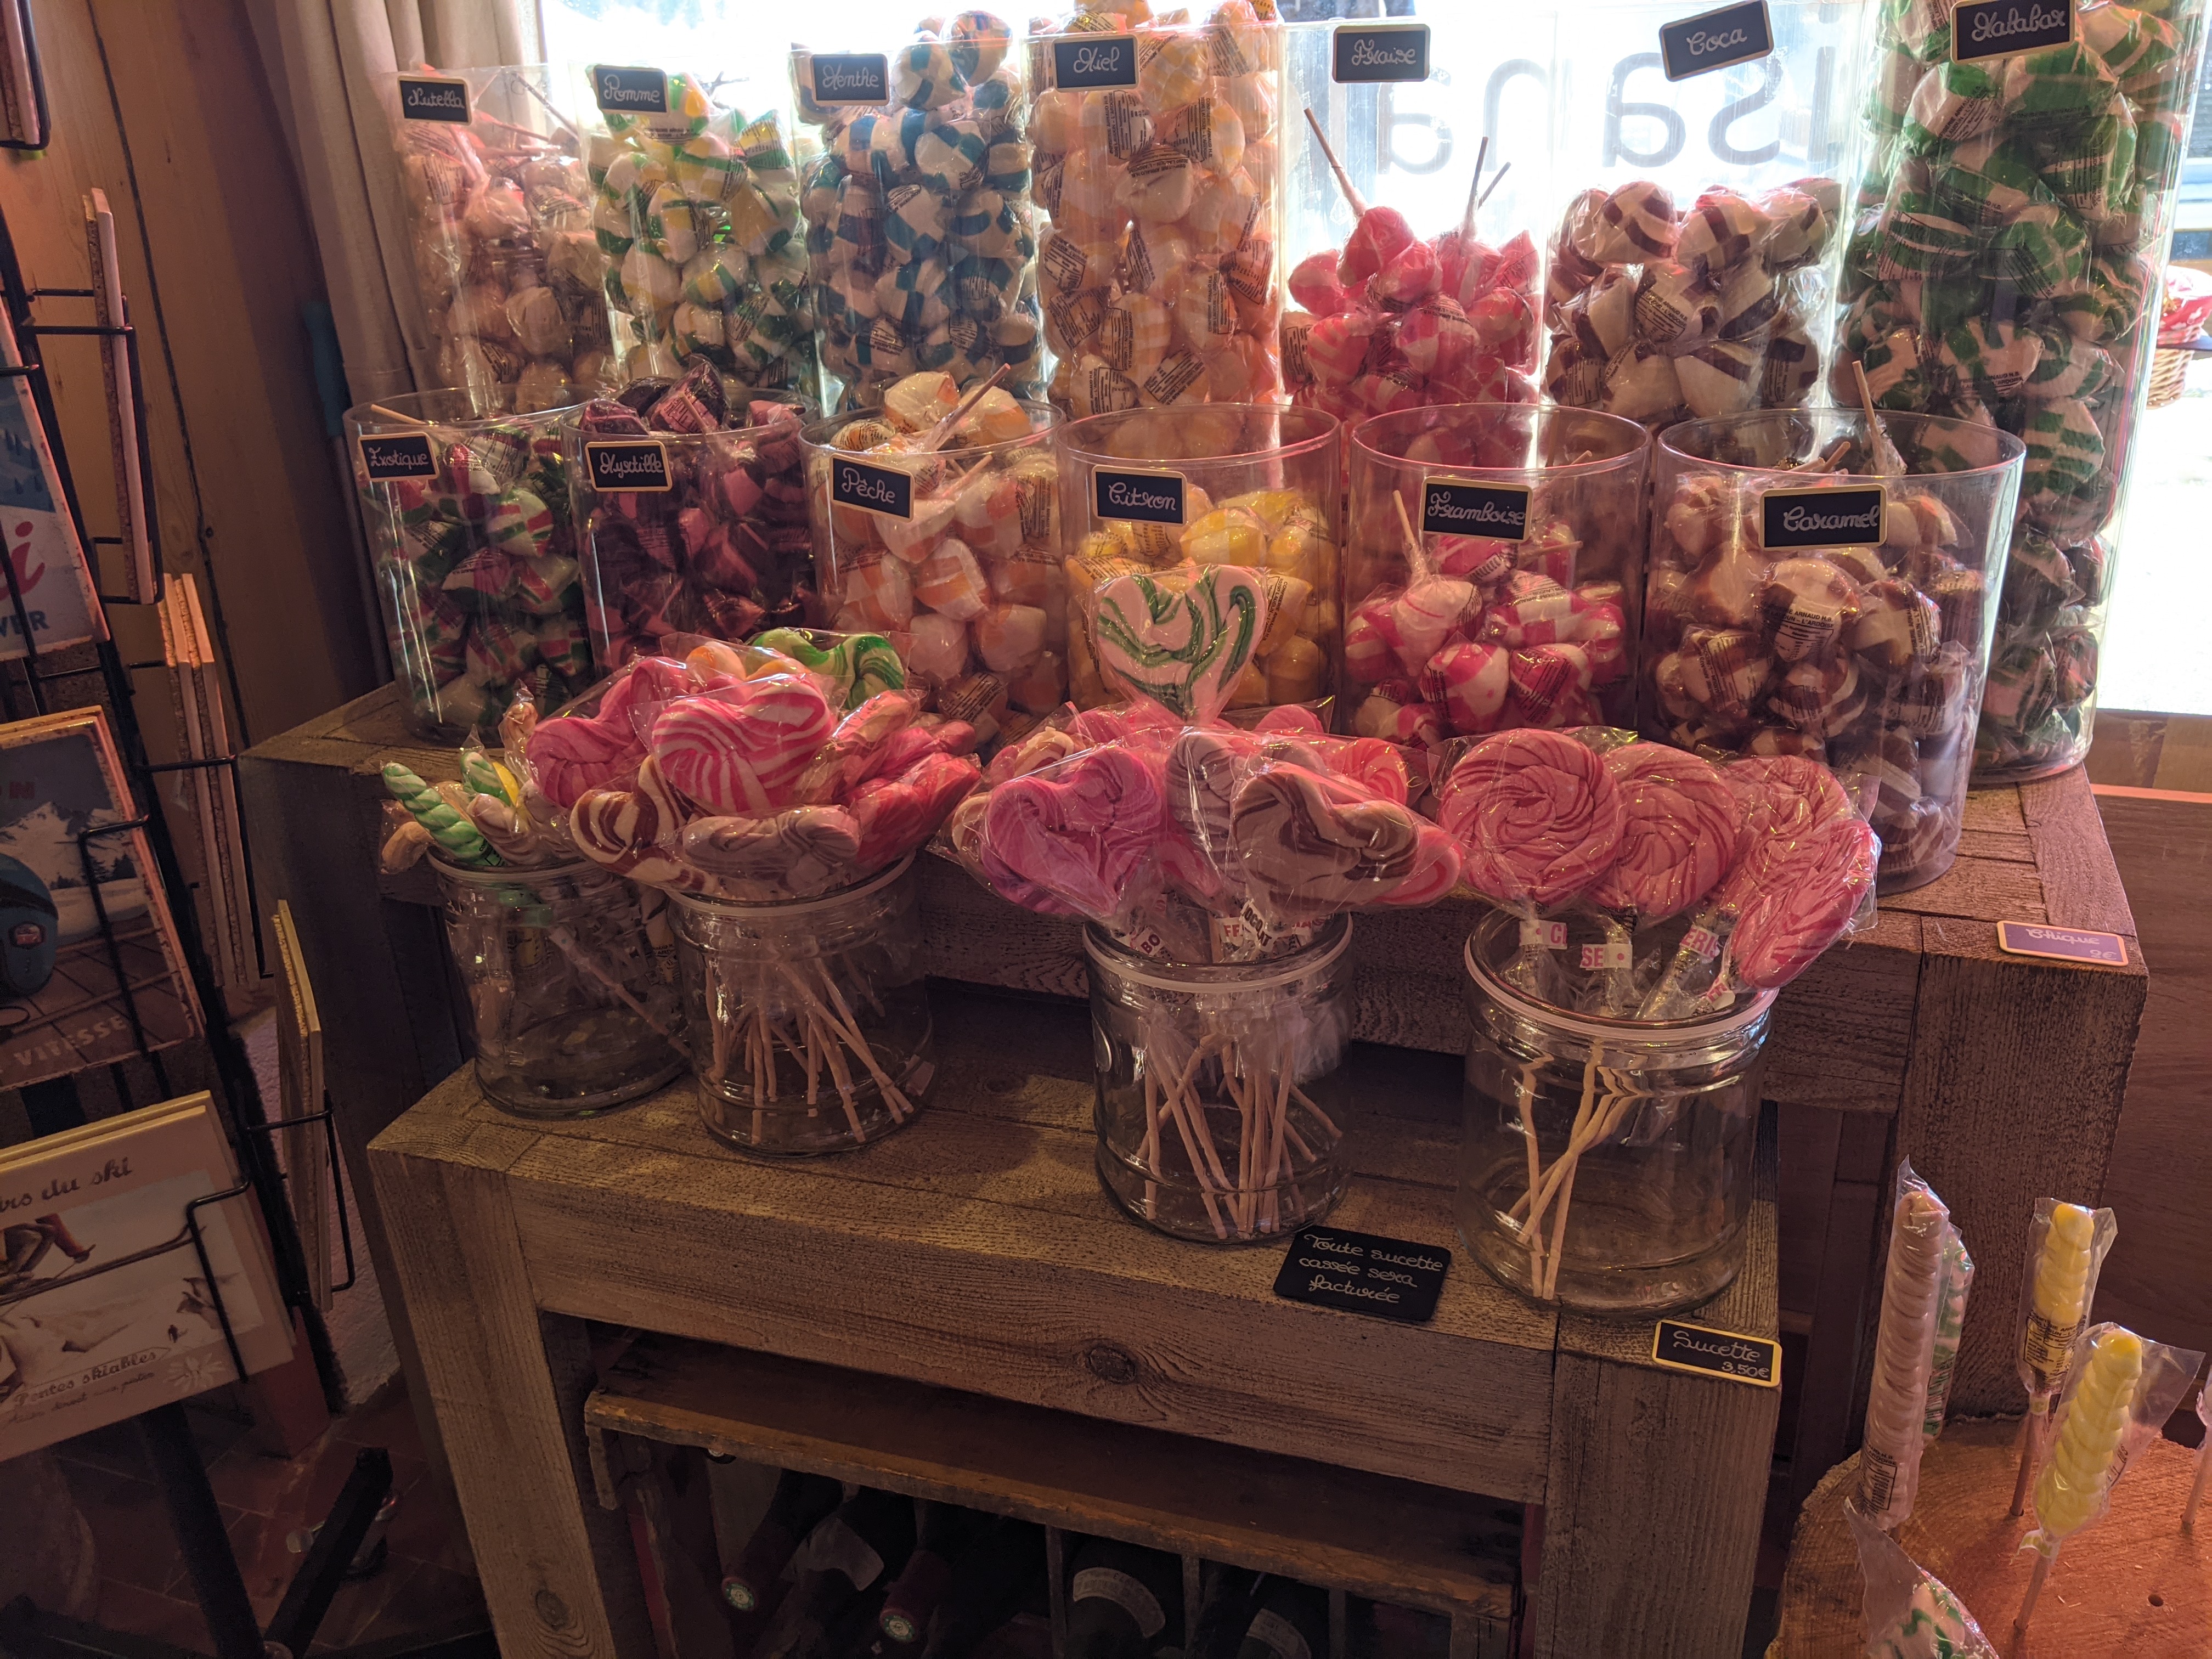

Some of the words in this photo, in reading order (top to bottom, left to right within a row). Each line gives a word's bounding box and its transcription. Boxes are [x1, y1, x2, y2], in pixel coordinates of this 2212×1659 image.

[1971, 3, 2066, 42] Malabar
[1351, 38, 1417, 66] Fraise
[1686, 26, 1747, 57] Coca
[1073, 46, 1120, 74] Miel
[603, 74, 661, 104] Pomme
[822, 64, 879, 91] Menthe
[407, 87, 465, 110] Nutella
[370, 447, 429, 470] Exotique
[599, 452, 664, 478] Myrtille
[840, 466, 896, 504] Pêche
[1108, 482, 1176, 511] Citron
[1427, 490, 1526, 526] Framboise
[1783, 504, 1880, 532] Caramel
[2089, 949, 2118, 961] 2€
[41, 1178, 81, 1201] du
[91, 1156, 133, 1186] ski
[1303, 1233, 1364, 1257] Toute
[1369, 1249, 1444, 1272] sucette
[1299, 1257, 1361, 1276] cassée
[1367, 1267, 1418, 1289] sera
[1308, 1274, 1401, 1304] facturée
[1672, 1330, 1762, 1363] Sucette
[1721, 1361, 1770, 1379] 3,50€
